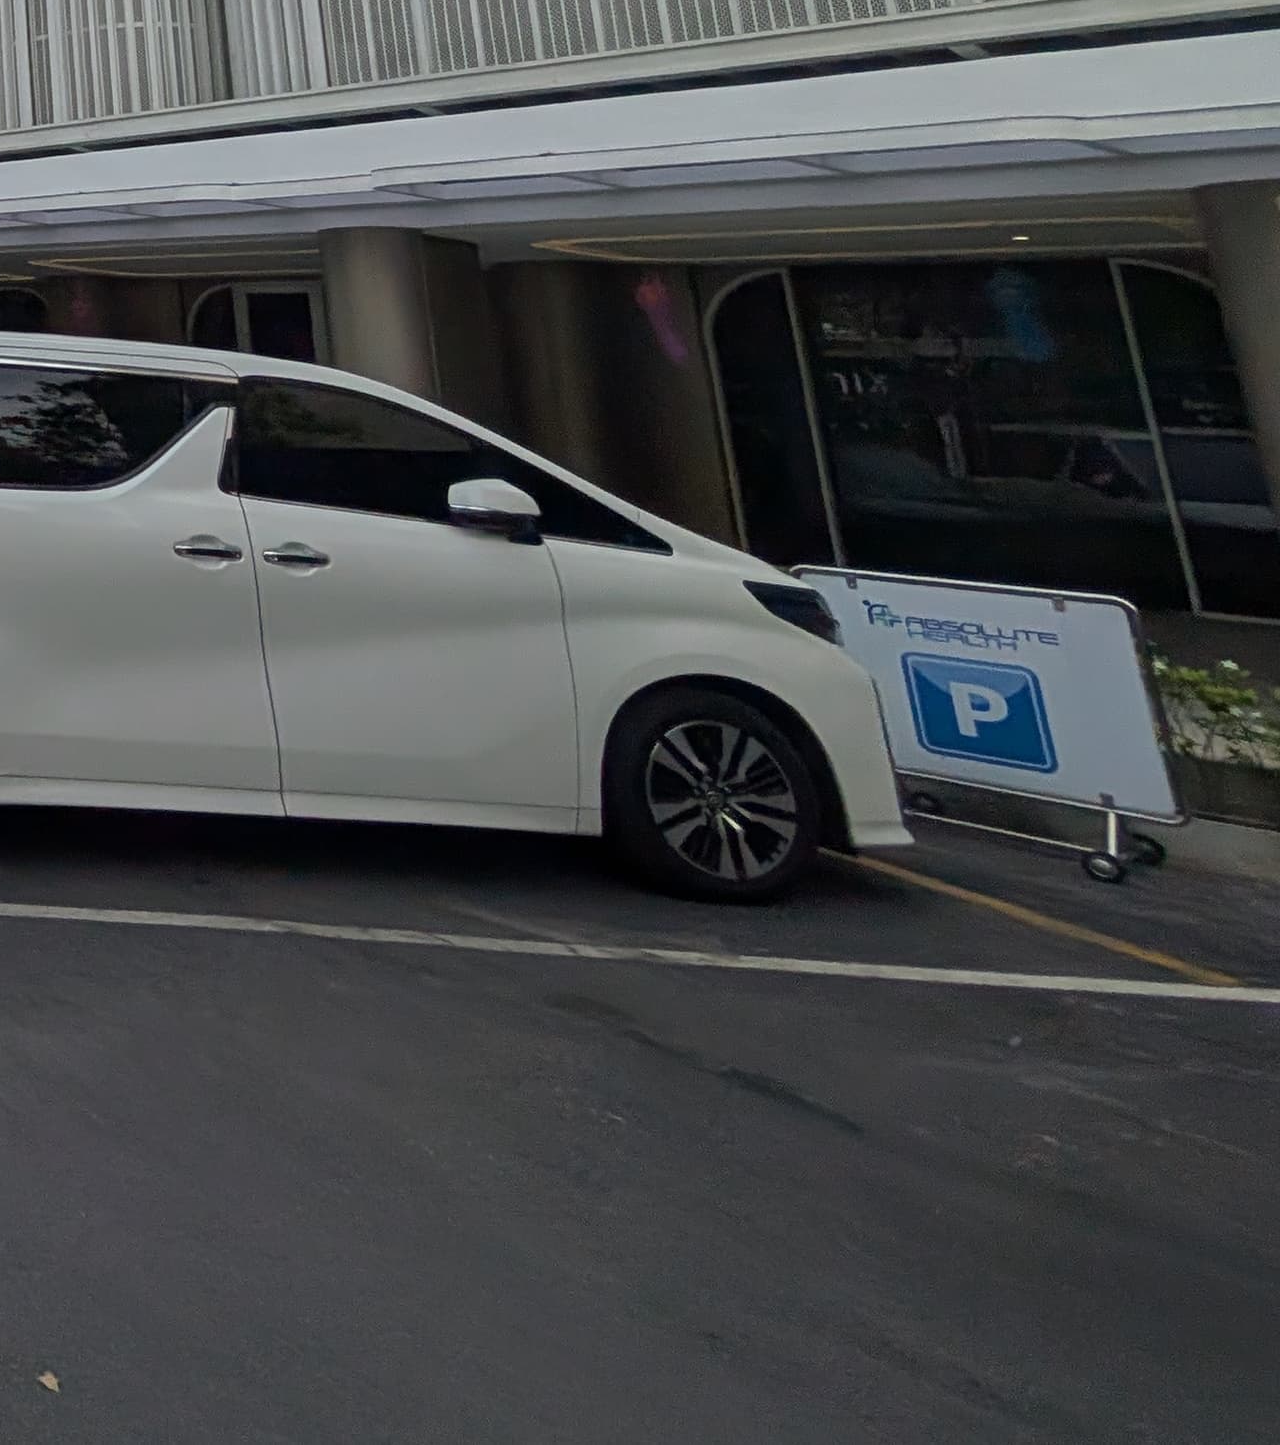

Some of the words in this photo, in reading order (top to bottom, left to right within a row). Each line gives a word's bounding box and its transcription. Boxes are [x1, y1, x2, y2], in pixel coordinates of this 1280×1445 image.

[905, 616, 1060, 646] ABSOLUTE
[907, 628, 1018, 651] HEALTH
[949, 682, 1008, 738] P
